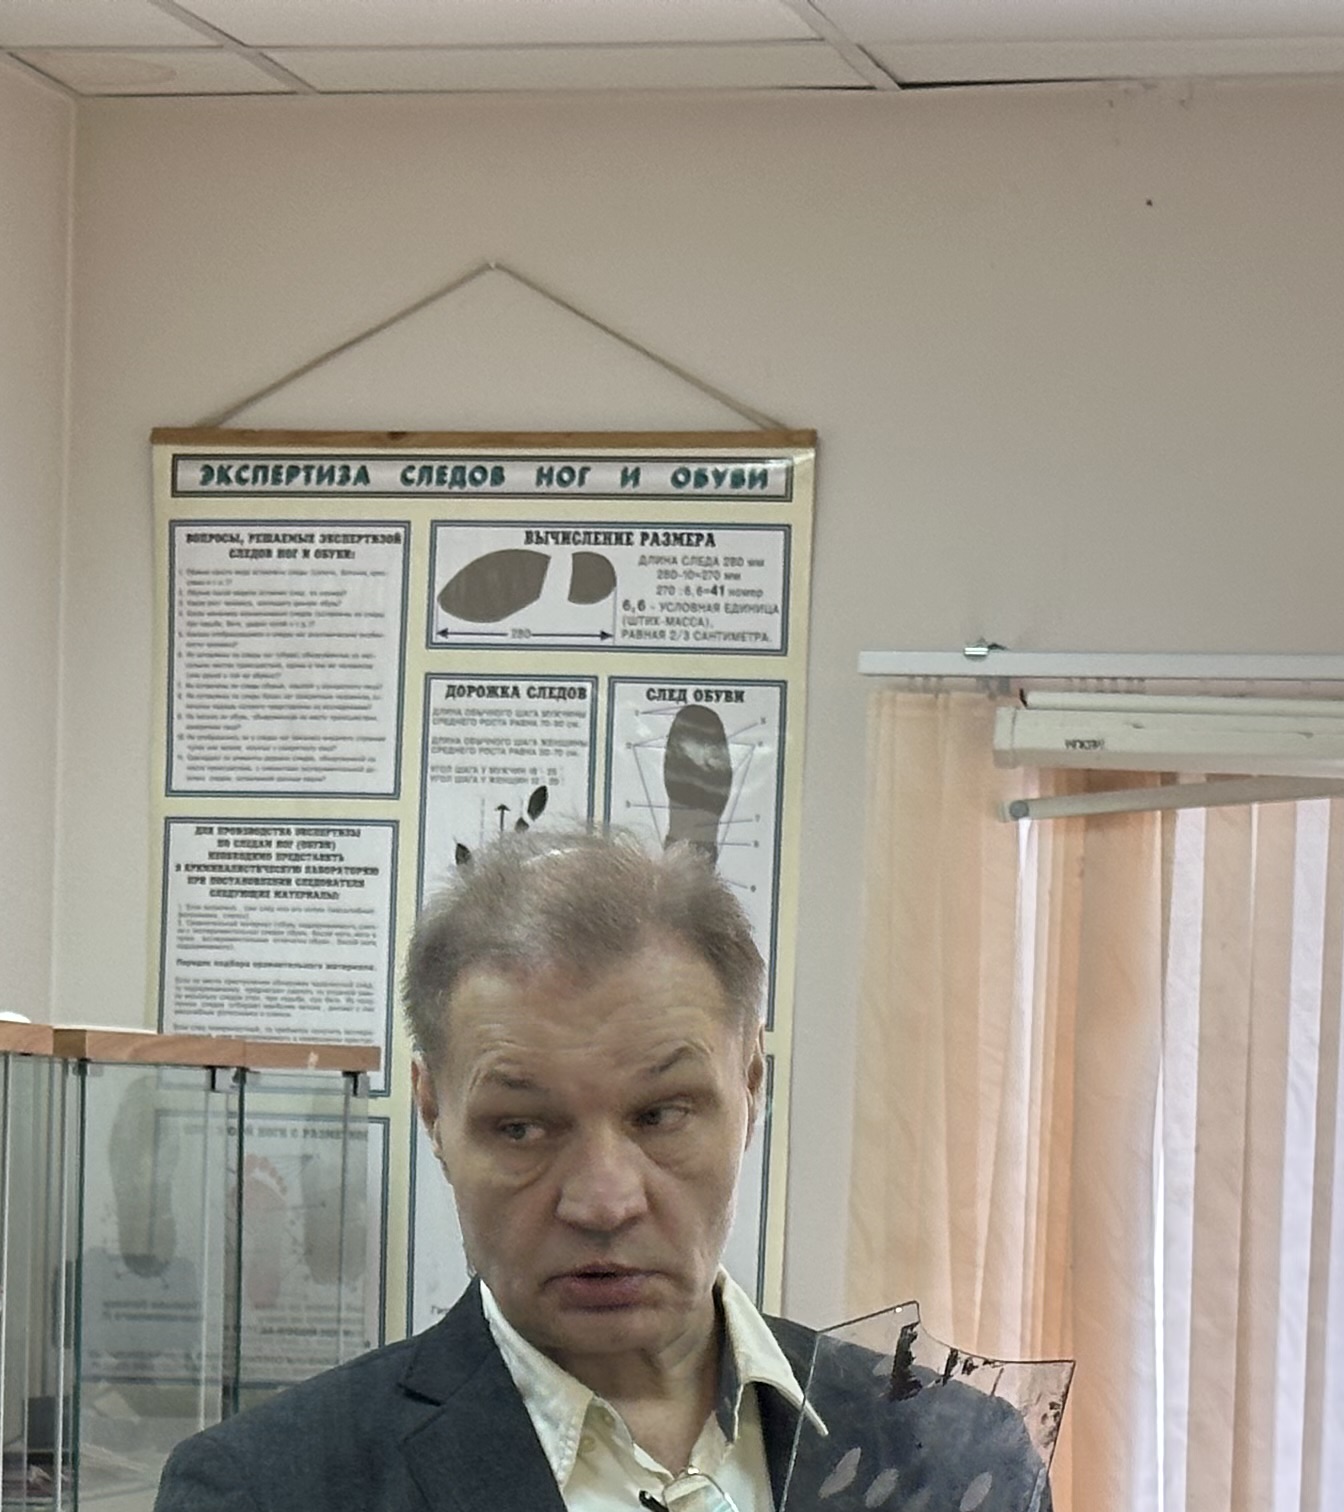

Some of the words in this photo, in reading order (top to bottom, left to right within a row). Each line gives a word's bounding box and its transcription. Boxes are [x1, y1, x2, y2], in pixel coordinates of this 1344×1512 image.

[199, 464, 371, 487] ЭКСПЕРТИЗА
[400, 465, 506, 489] СЛЕДОВ
[535, 465, 591, 488] НОГ
[620, 466, 641, 488] И
[670, 466, 769, 489] ОБУВИ
[524, 530, 634, 546] ВЫЧИСЛЕНИЕ
[640, 532, 716, 547] РАЗМЕРА
[638, 555, 678, 567] ДЛИНА
[681, 555, 719, 567] СЛЕДА
[723, 557, 744, 567] 280
[659, 602, 721, 613] УСЛОВНАЯ
[724, 603, 779, 615] ЕДИНИЦА
[621, 629, 667, 640] РАВНАЯ
[669, 631, 690, 641] 2/3
[445, 684, 521, 699] ДОРОЖКА
[526, 686, 587, 701] СЛЕДОВ
[646, 687, 688, 704] СЛЕД
[693, 688, 745, 703] ОБУВИ
